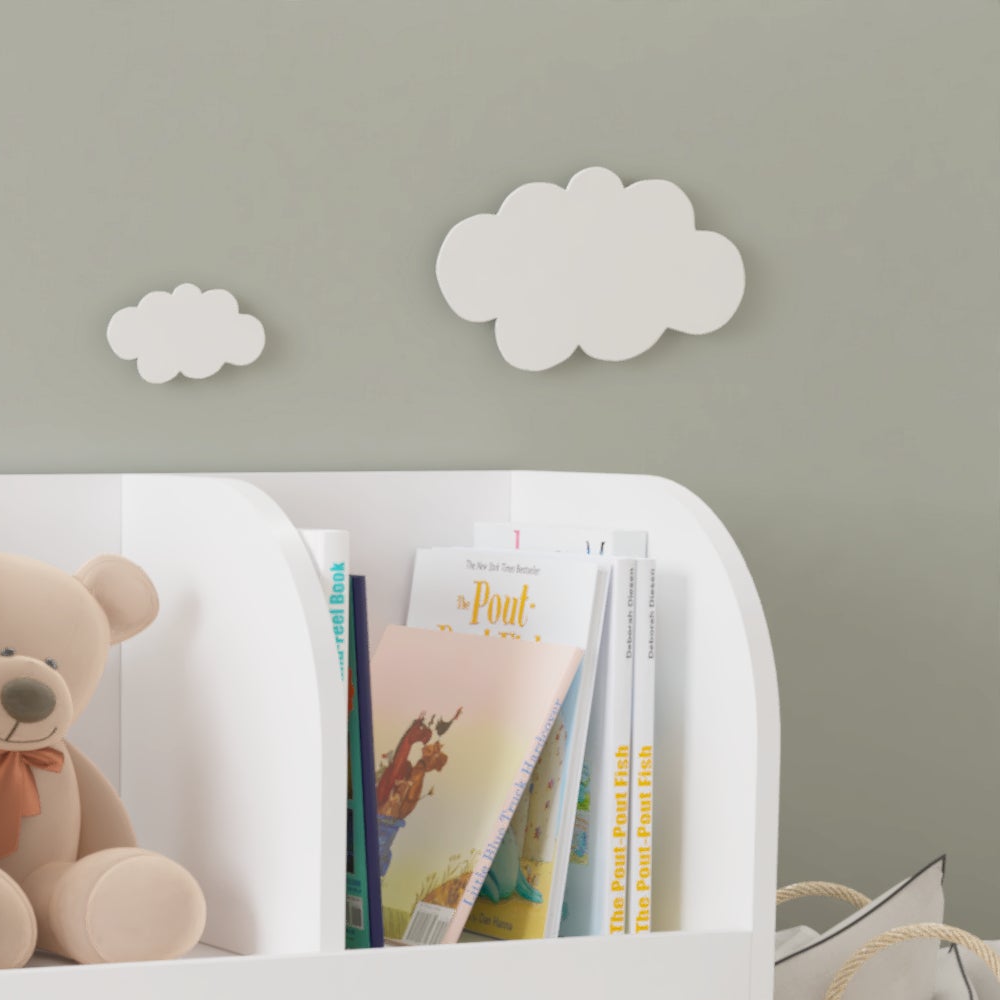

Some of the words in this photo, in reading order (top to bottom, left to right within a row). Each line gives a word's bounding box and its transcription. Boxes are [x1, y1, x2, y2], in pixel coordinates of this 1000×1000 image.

[328, 561, 346, 605] Book
[625, 610, 633, 659] Deborah
[614, 745, 629, 787] Fish
[637, 745, 653, 787] Fish
[611, 792, 628, 891] Pout-Pout
[636, 792, 652, 891] Pout-Pout
[609, 897, 625, 935] The
[635, 897, 650, 934] The
